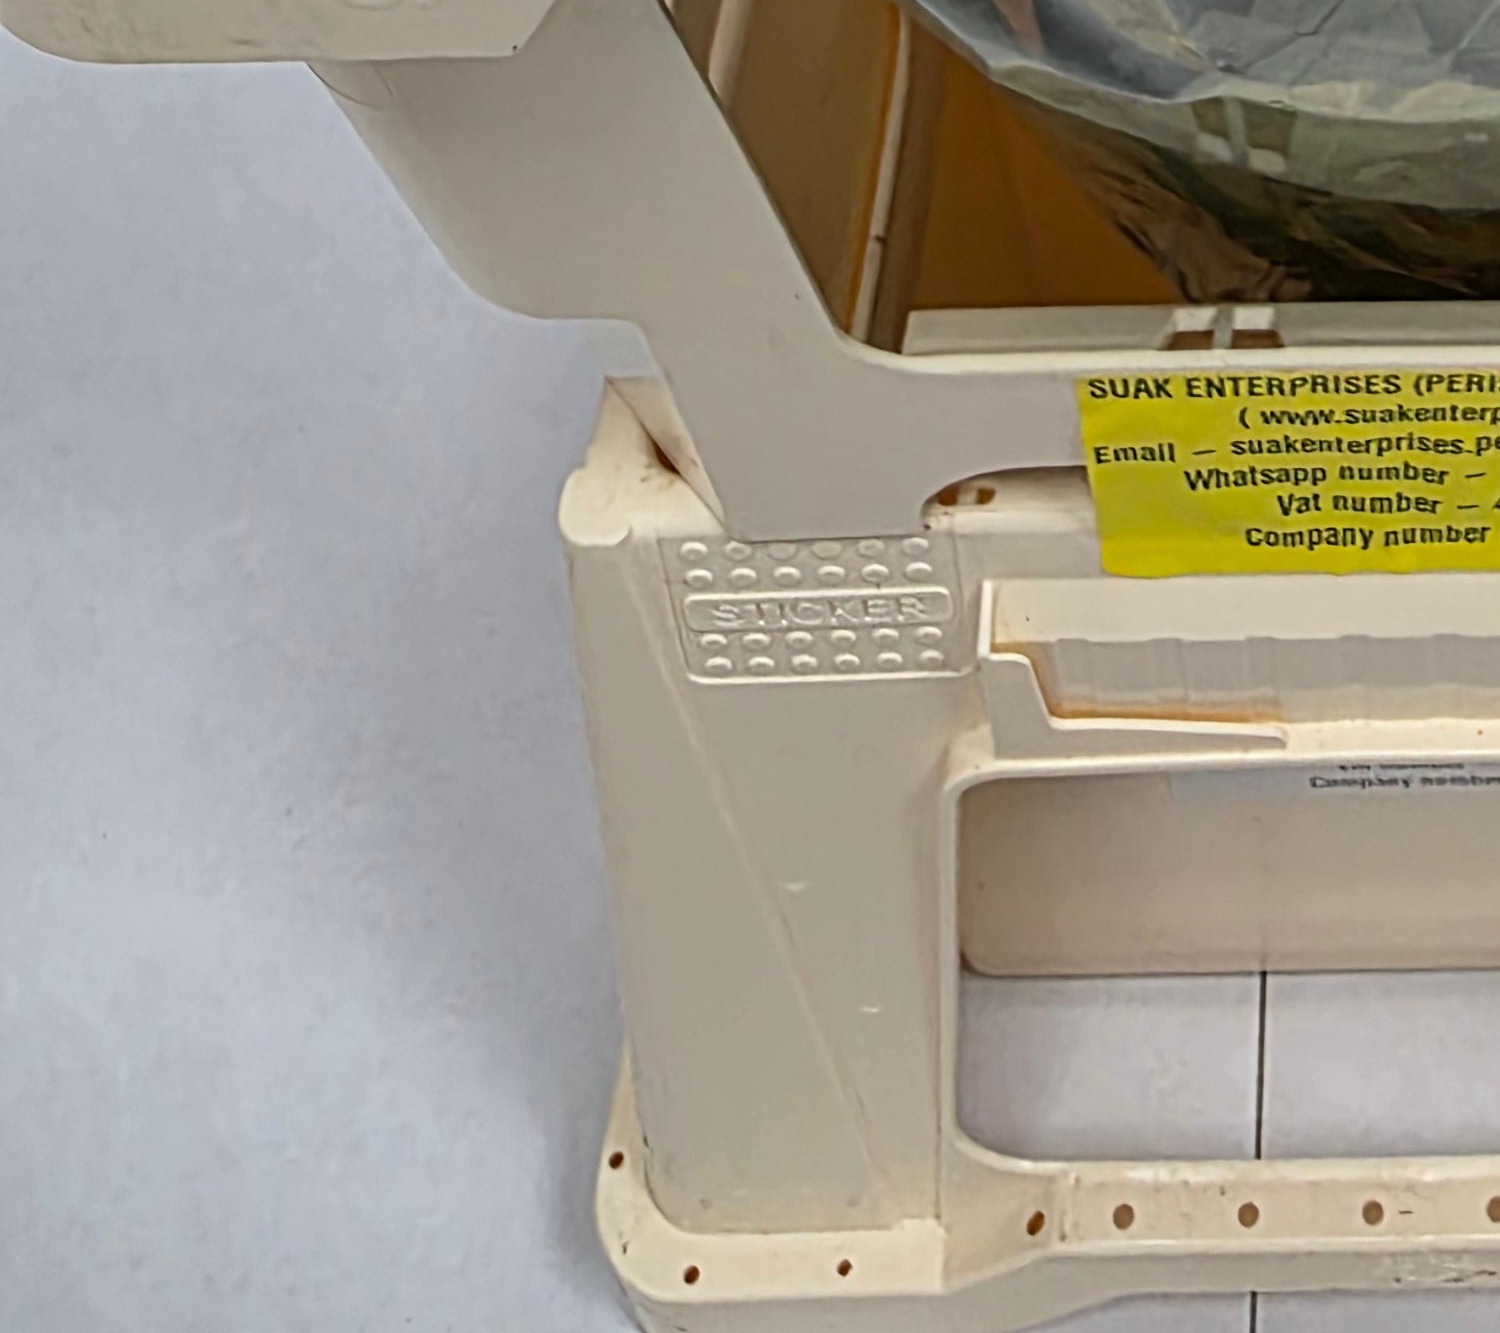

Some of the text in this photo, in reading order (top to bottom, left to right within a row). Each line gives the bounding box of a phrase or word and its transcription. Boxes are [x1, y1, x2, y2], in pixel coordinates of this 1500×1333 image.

[1088, 378, 1173, 399] SUAK
[1186, 375, 1402, 398] ENTERPRISES
[1094, 443, 1175, 464] Email
[1184, 464, 1327, 491] Whatsapp
[1339, 462, 1450, 485] number
[1277, 493, 1321, 516] Vat
[1333, 492, 1442, 515] number
[1245, 527, 1373, 551] Company
[1384, 524, 1491, 547] number
[712, 597, 928, 630] STICKER
